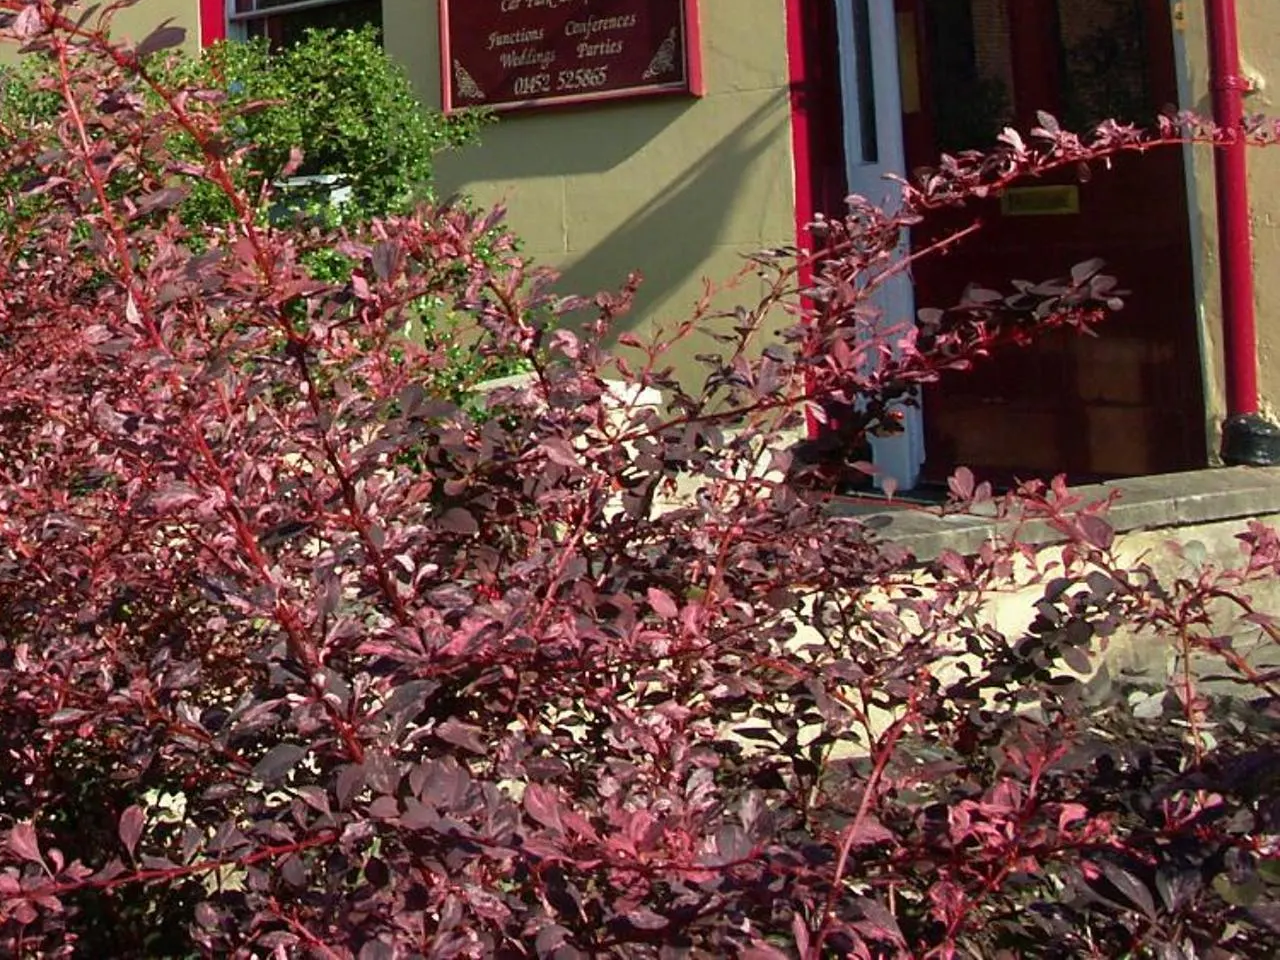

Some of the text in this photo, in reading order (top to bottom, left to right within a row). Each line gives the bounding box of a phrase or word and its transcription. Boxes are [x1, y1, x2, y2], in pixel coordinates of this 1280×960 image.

[486, 13, 637, 50] Functions Conferences
[499, 38, 624, 70] Weddings Parties
[513, 65, 609, 96] 01452 525865
